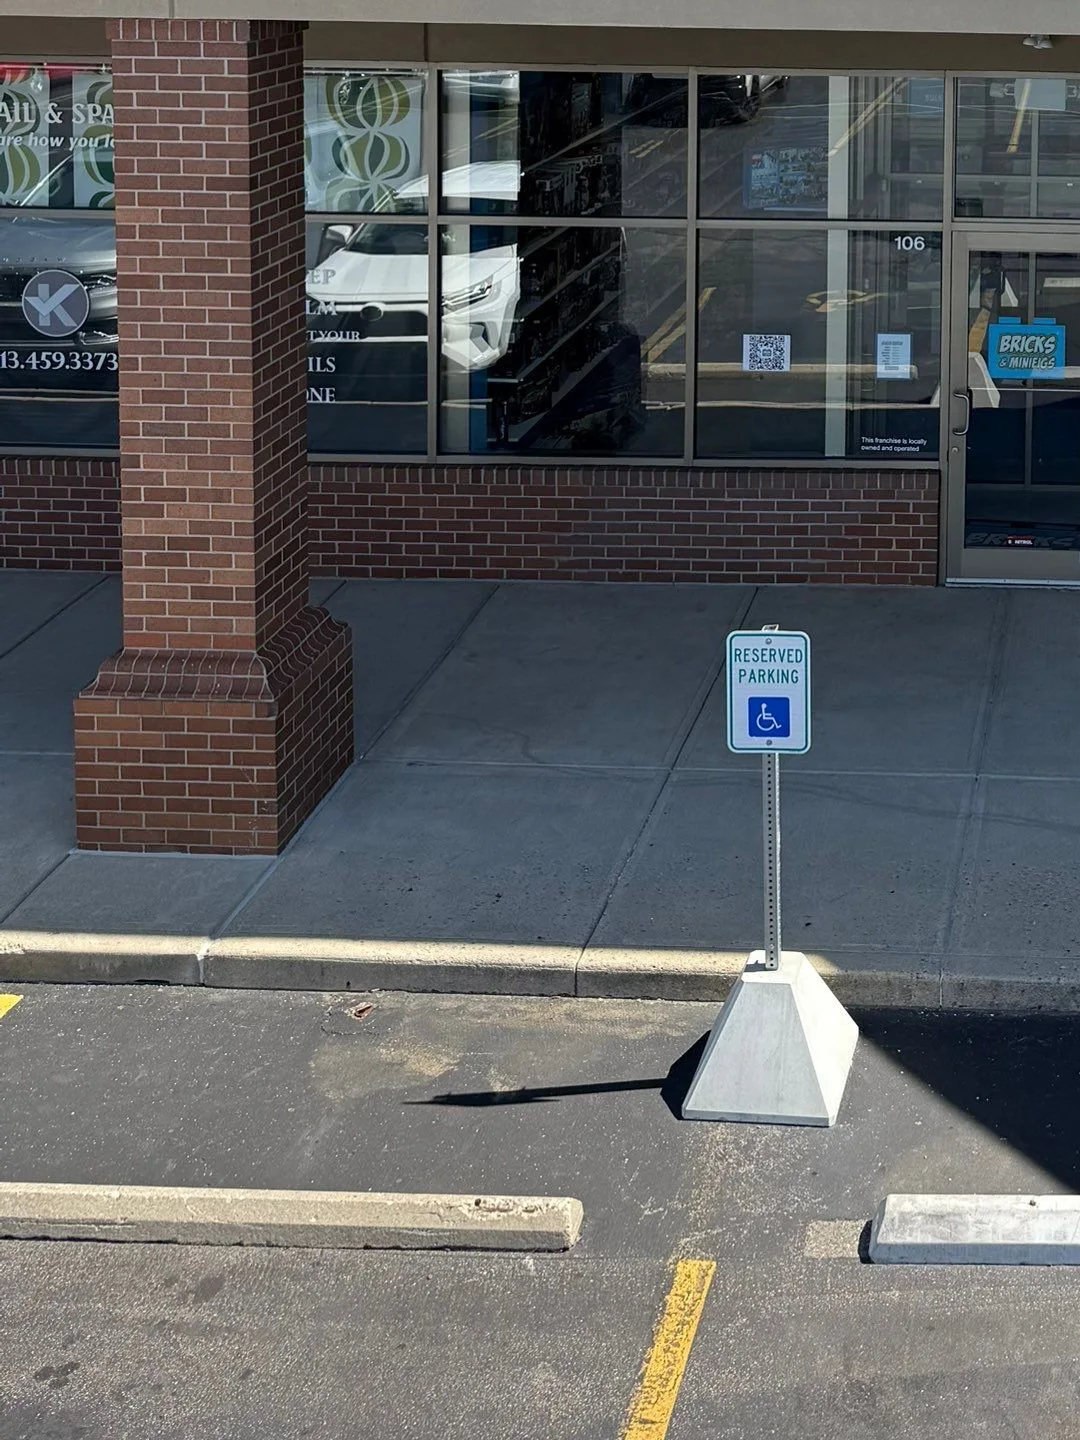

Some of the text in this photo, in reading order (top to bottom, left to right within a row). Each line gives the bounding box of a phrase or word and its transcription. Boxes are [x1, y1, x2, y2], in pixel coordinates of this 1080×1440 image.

[45, 102, 63, 124] &
[72, 103, 114, 125] SPA
[28, 132, 64, 147] how
[69, 137, 99, 151] you
[894, 235, 925, 251] 106
[999, 335, 1056, 354] BRICKS
[999, 357, 1056, 369] & MINIFIGS
[908, 438, 928, 446] locally
[734, 648, 803, 663] RESERVED
[738, 669, 799, 684] PARKING
